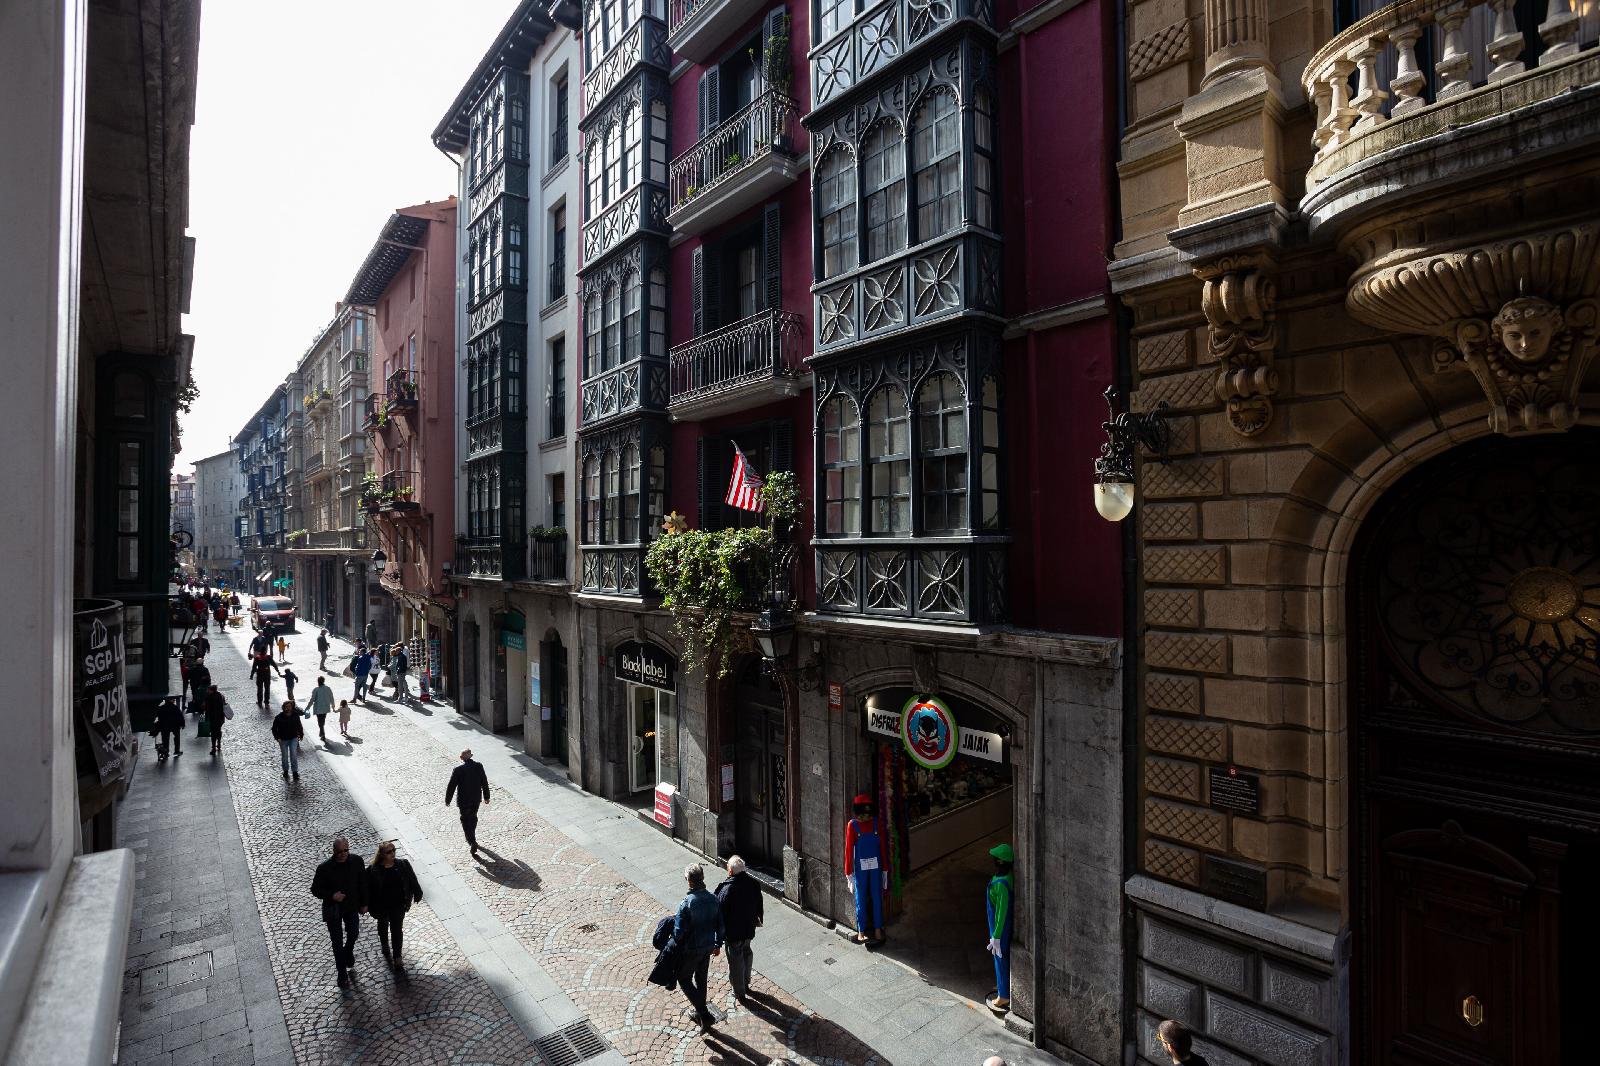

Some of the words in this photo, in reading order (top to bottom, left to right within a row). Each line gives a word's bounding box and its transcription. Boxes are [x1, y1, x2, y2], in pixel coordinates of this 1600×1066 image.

[85, 649, 112, 675] SGP
[643, 657, 667, 679] label
[962, 732, 990, 754] JAIAK
